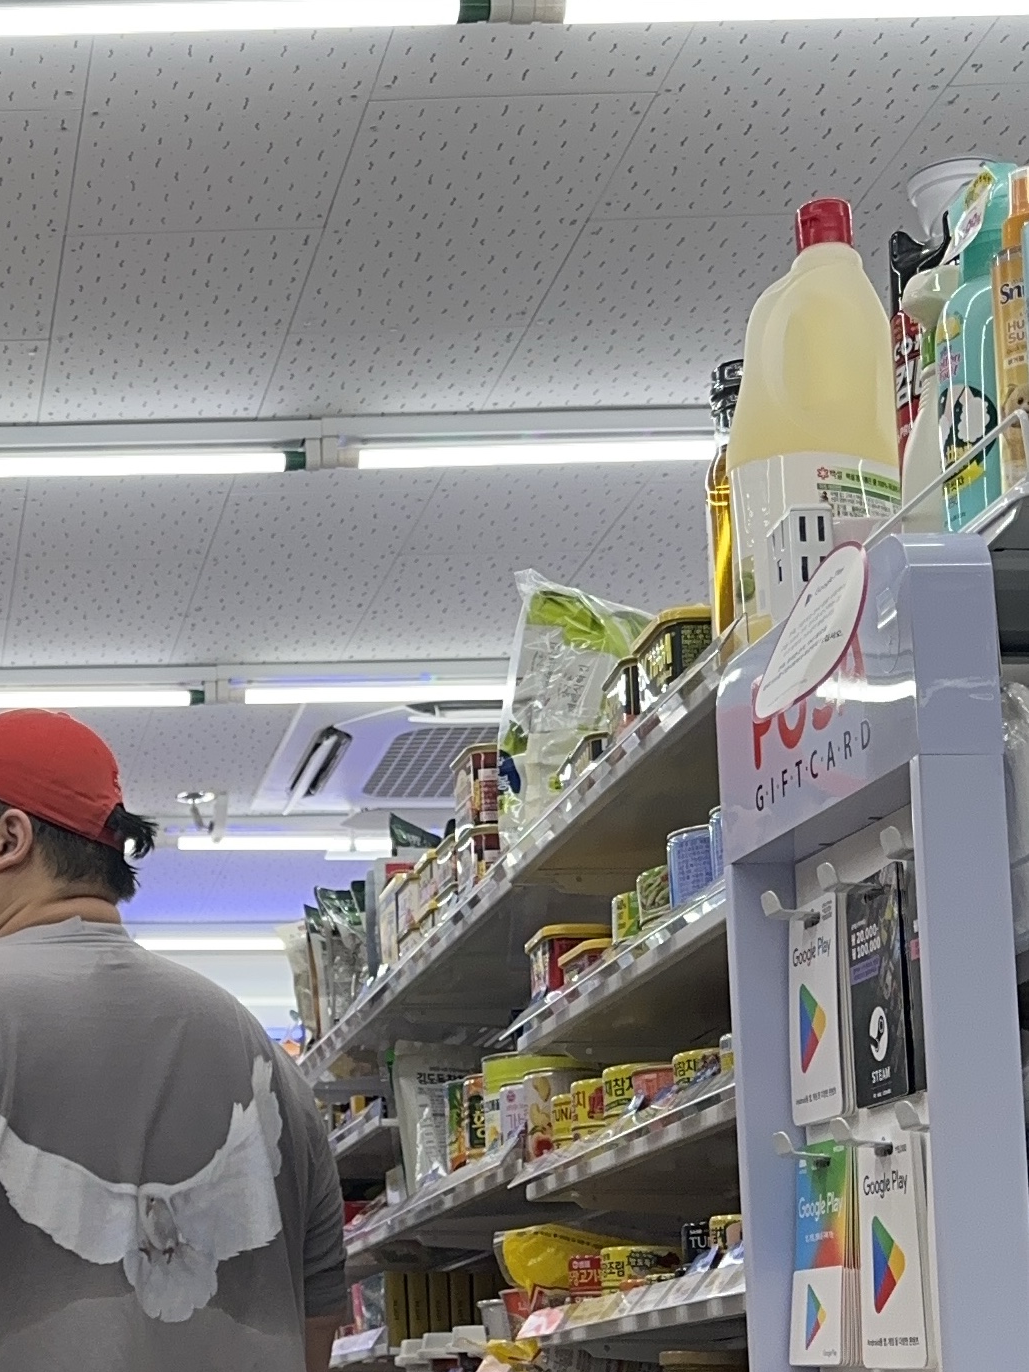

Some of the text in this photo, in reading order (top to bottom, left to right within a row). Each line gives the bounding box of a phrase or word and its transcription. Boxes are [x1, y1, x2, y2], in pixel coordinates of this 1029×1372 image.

[871, 1066, 891, 1084] STEAM
[863, 1170, 908, 1199] Google Play
[798, 1194, 827, 1222] Google
